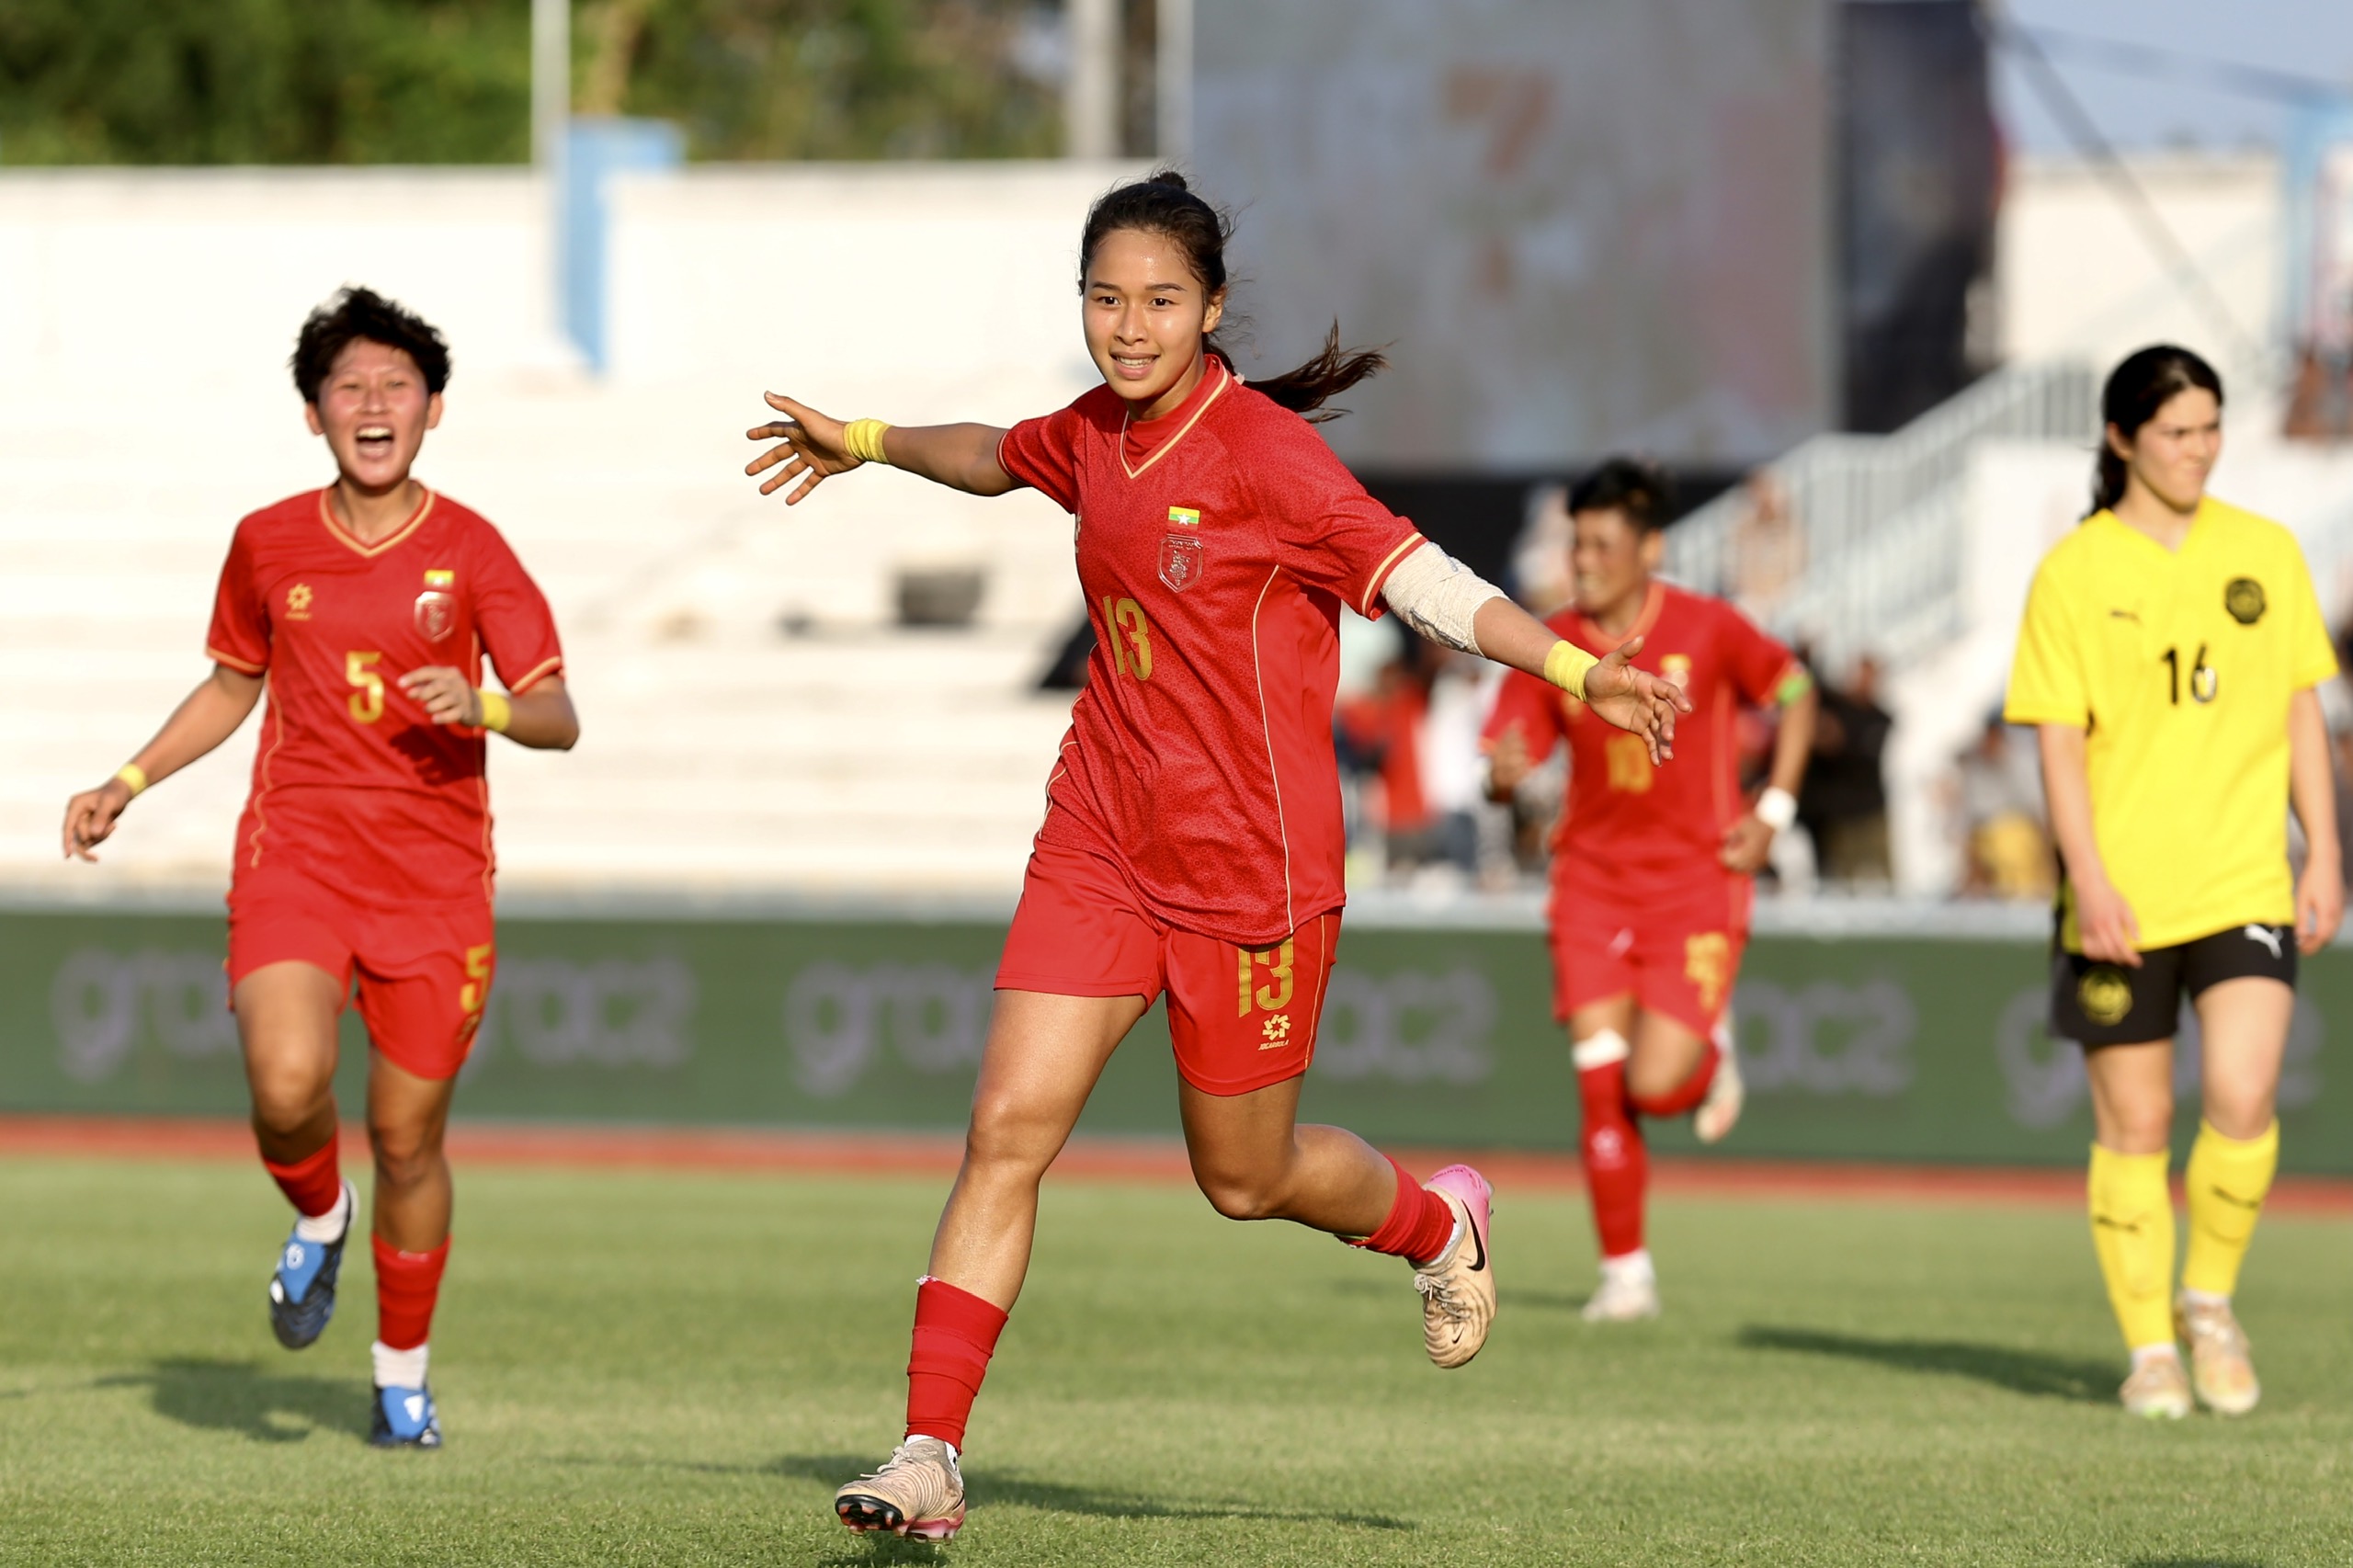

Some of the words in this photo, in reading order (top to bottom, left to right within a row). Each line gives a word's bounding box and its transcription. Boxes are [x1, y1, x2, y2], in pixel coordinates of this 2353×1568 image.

[1103, 596, 1153, 681] 13
[2161, 642, 2218, 706] 16
[346, 651, 384, 723] 5
[460, 943, 492, 1014] 5
[1238, 936, 1294, 1017] 13
